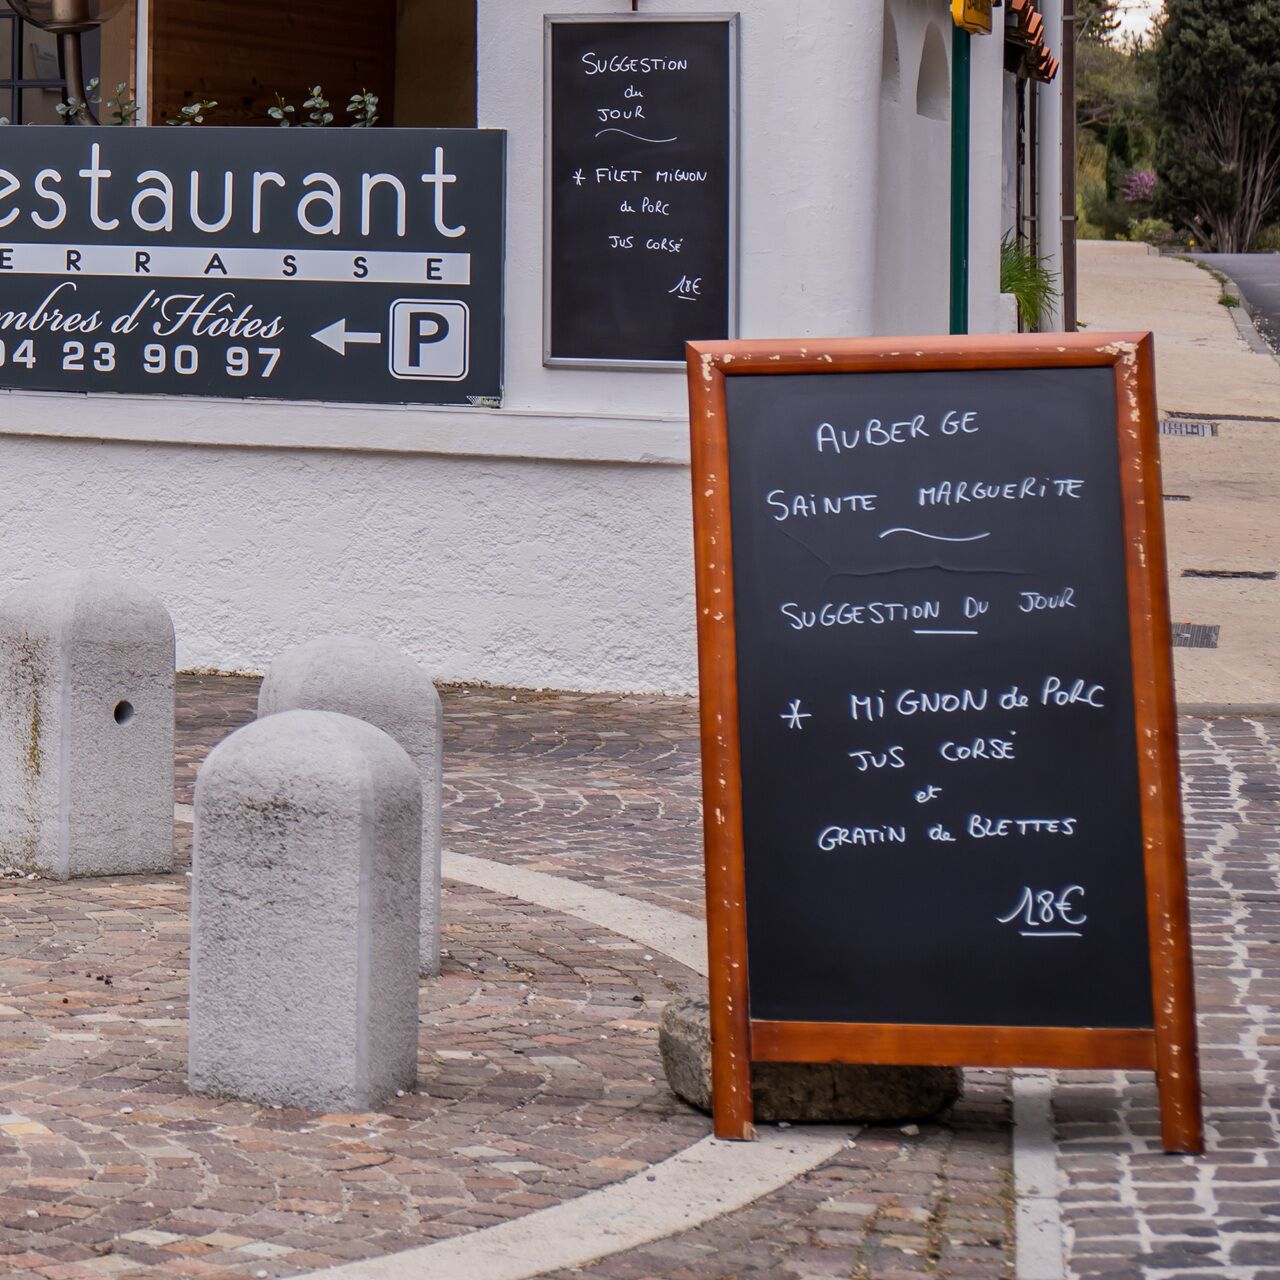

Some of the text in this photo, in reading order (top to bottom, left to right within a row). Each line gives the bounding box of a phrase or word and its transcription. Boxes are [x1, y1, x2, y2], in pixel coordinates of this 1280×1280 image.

[624, 85, 643, 98] du
[597, 106, 645, 121] JOUR
[620, 197, 669, 215] de PORC
[609, 236, 683, 252] JUS CORSÉ
[668, 275, 701, 294] 18€
[111, 290, 284, 338] d'Hôtes
[63, 341, 115, 371] 23
[144, 344, 198, 374] 90
[226, 347, 280, 377] 97
[1019, 588, 1076, 612] JOUR
[1000, 687, 1028, 709] de
[1041, 676, 1104, 707] PORC
[849, 746, 905, 771] JUS
[915, 785, 942, 803] et
[928, 824, 956, 841] de
[968, 814, 1077, 838] BLETTES
[996, 885, 1087, 925] 18€
